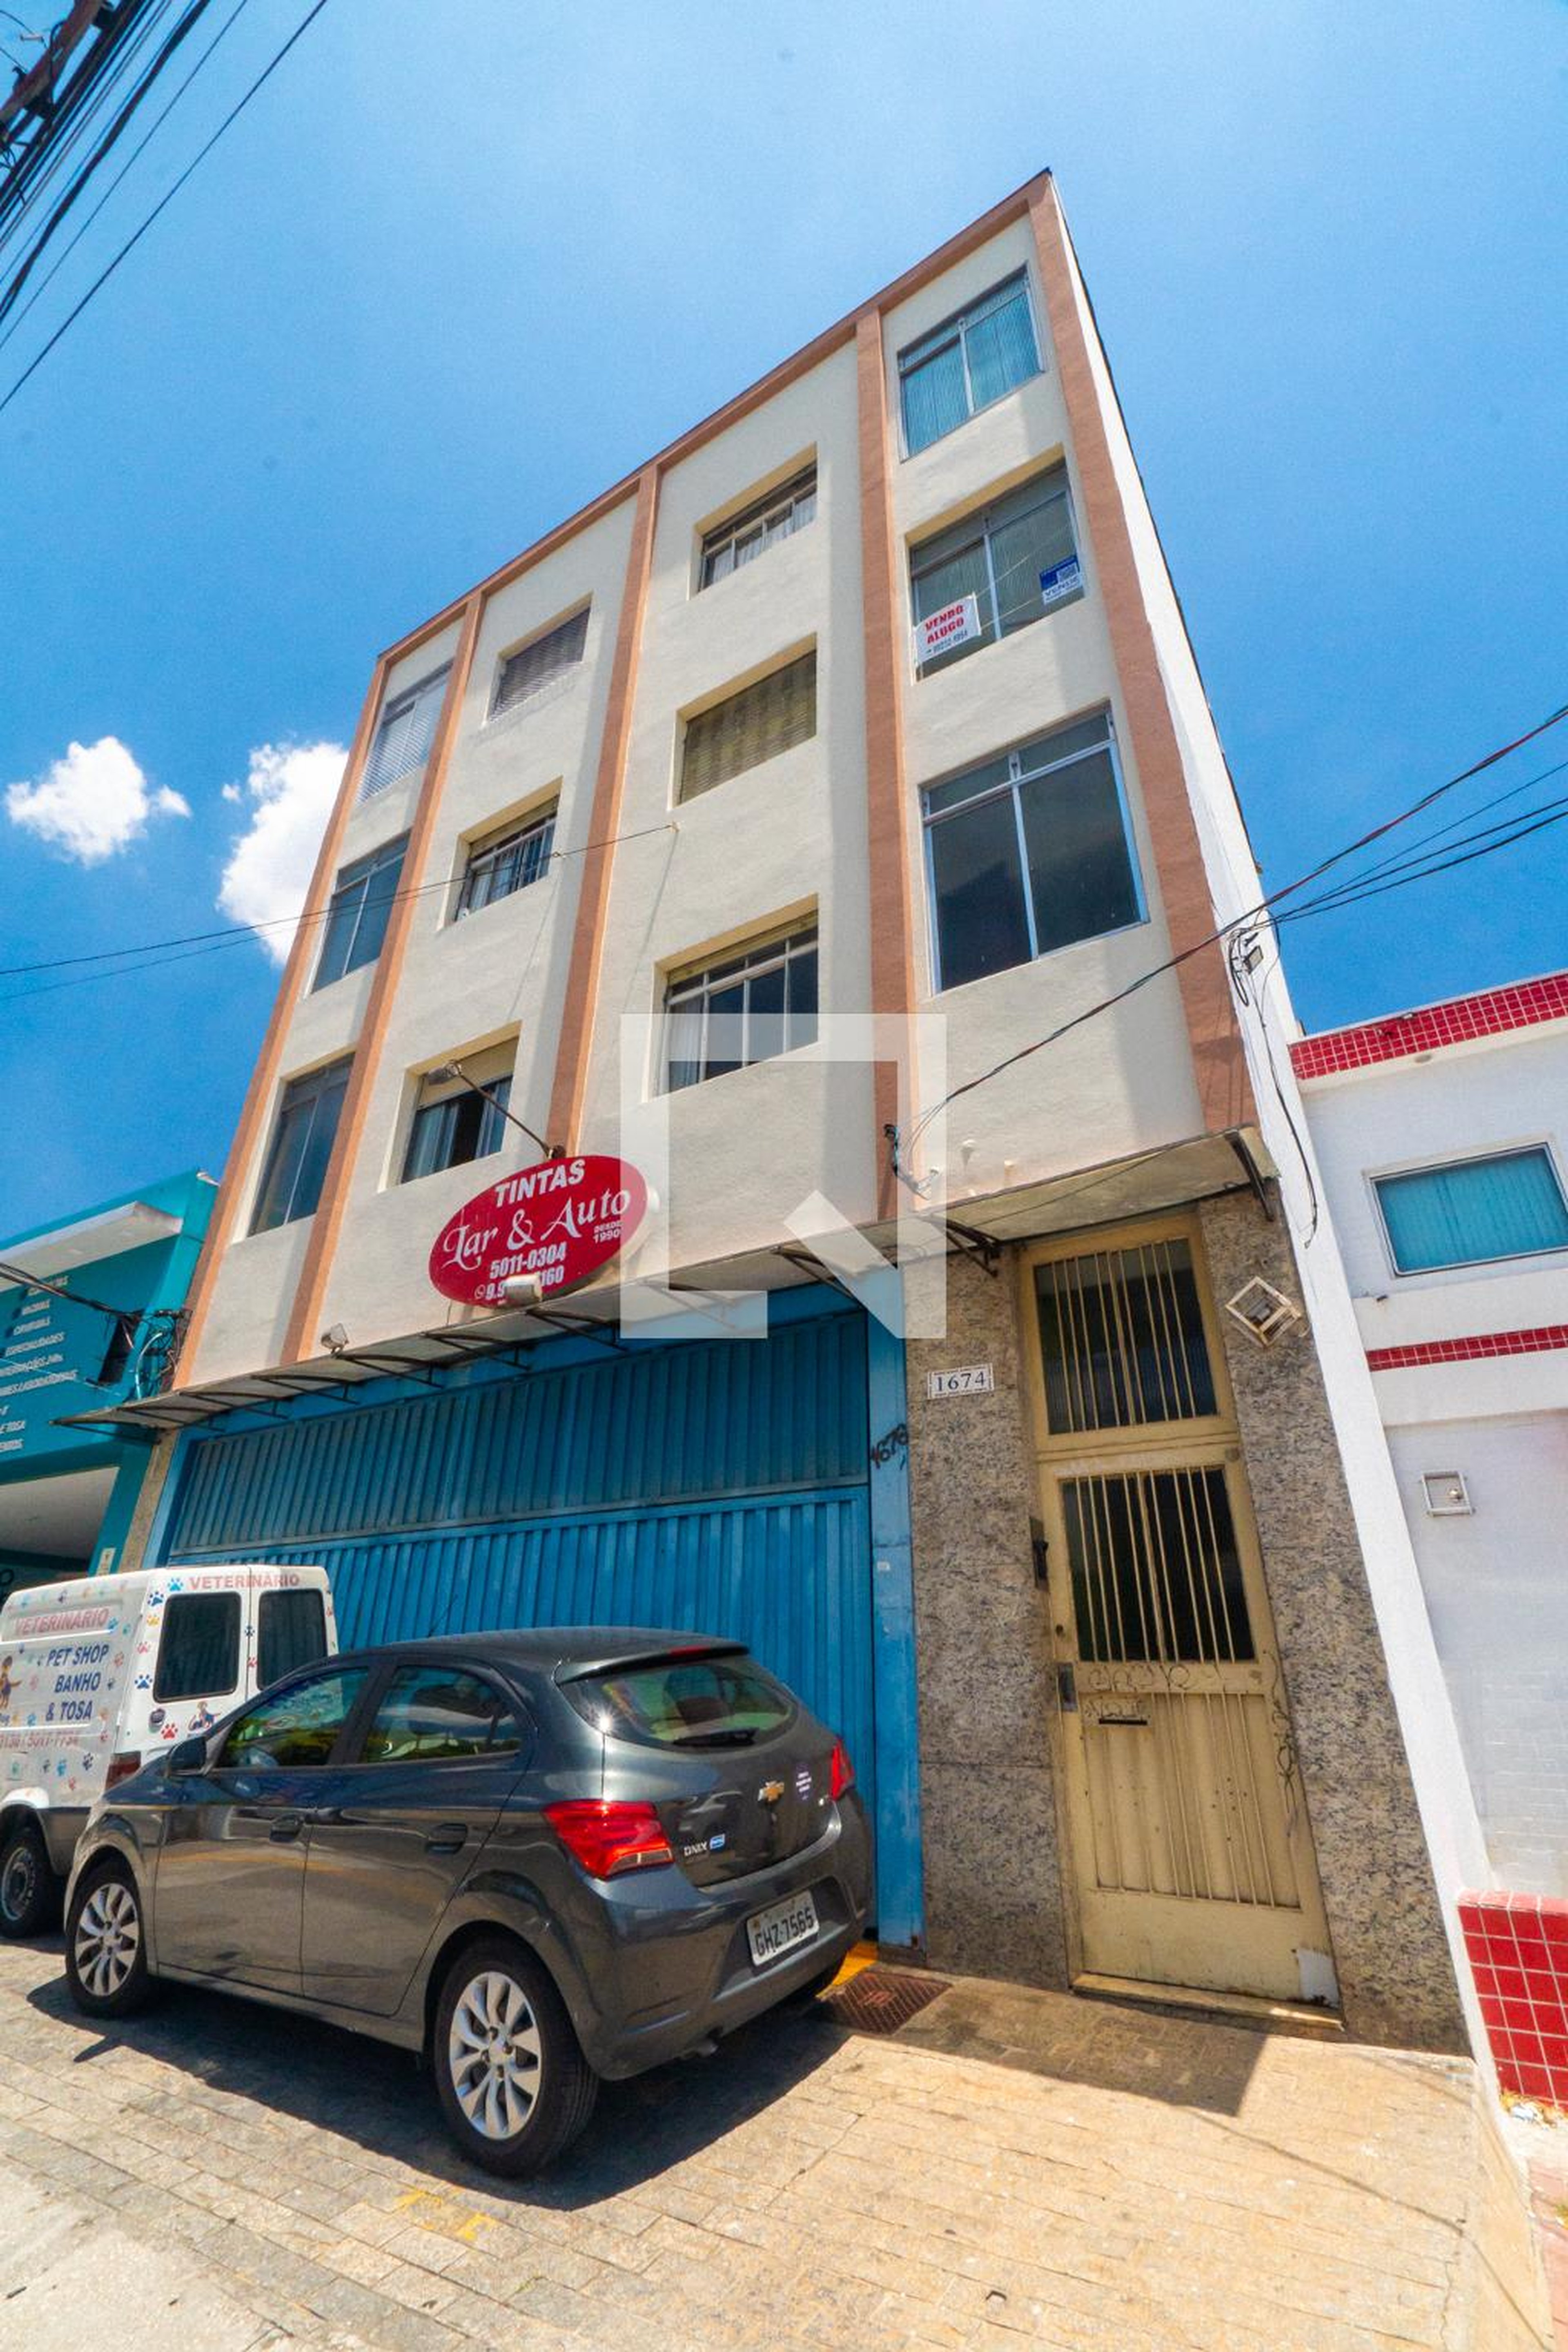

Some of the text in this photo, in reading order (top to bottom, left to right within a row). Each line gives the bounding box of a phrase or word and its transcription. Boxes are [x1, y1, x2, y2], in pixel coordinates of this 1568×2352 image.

[926, 605, 963, 631] VENDO
[927, 617, 964, 644] ALUGO
[494, 1158, 586, 1208] TINTAS
[507, 1209, 535, 1250] &
[540, 1188, 631, 1240] Auto
[490, 1241, 567, 1279] 5011-0304
[937, 1372, 986, 1392] 1674
[47, 1644, 109, 1666] PET SHOP
[54, 1672, 101, 1693] BANHO
[46, 1700, 93, 1722] & TOSA
